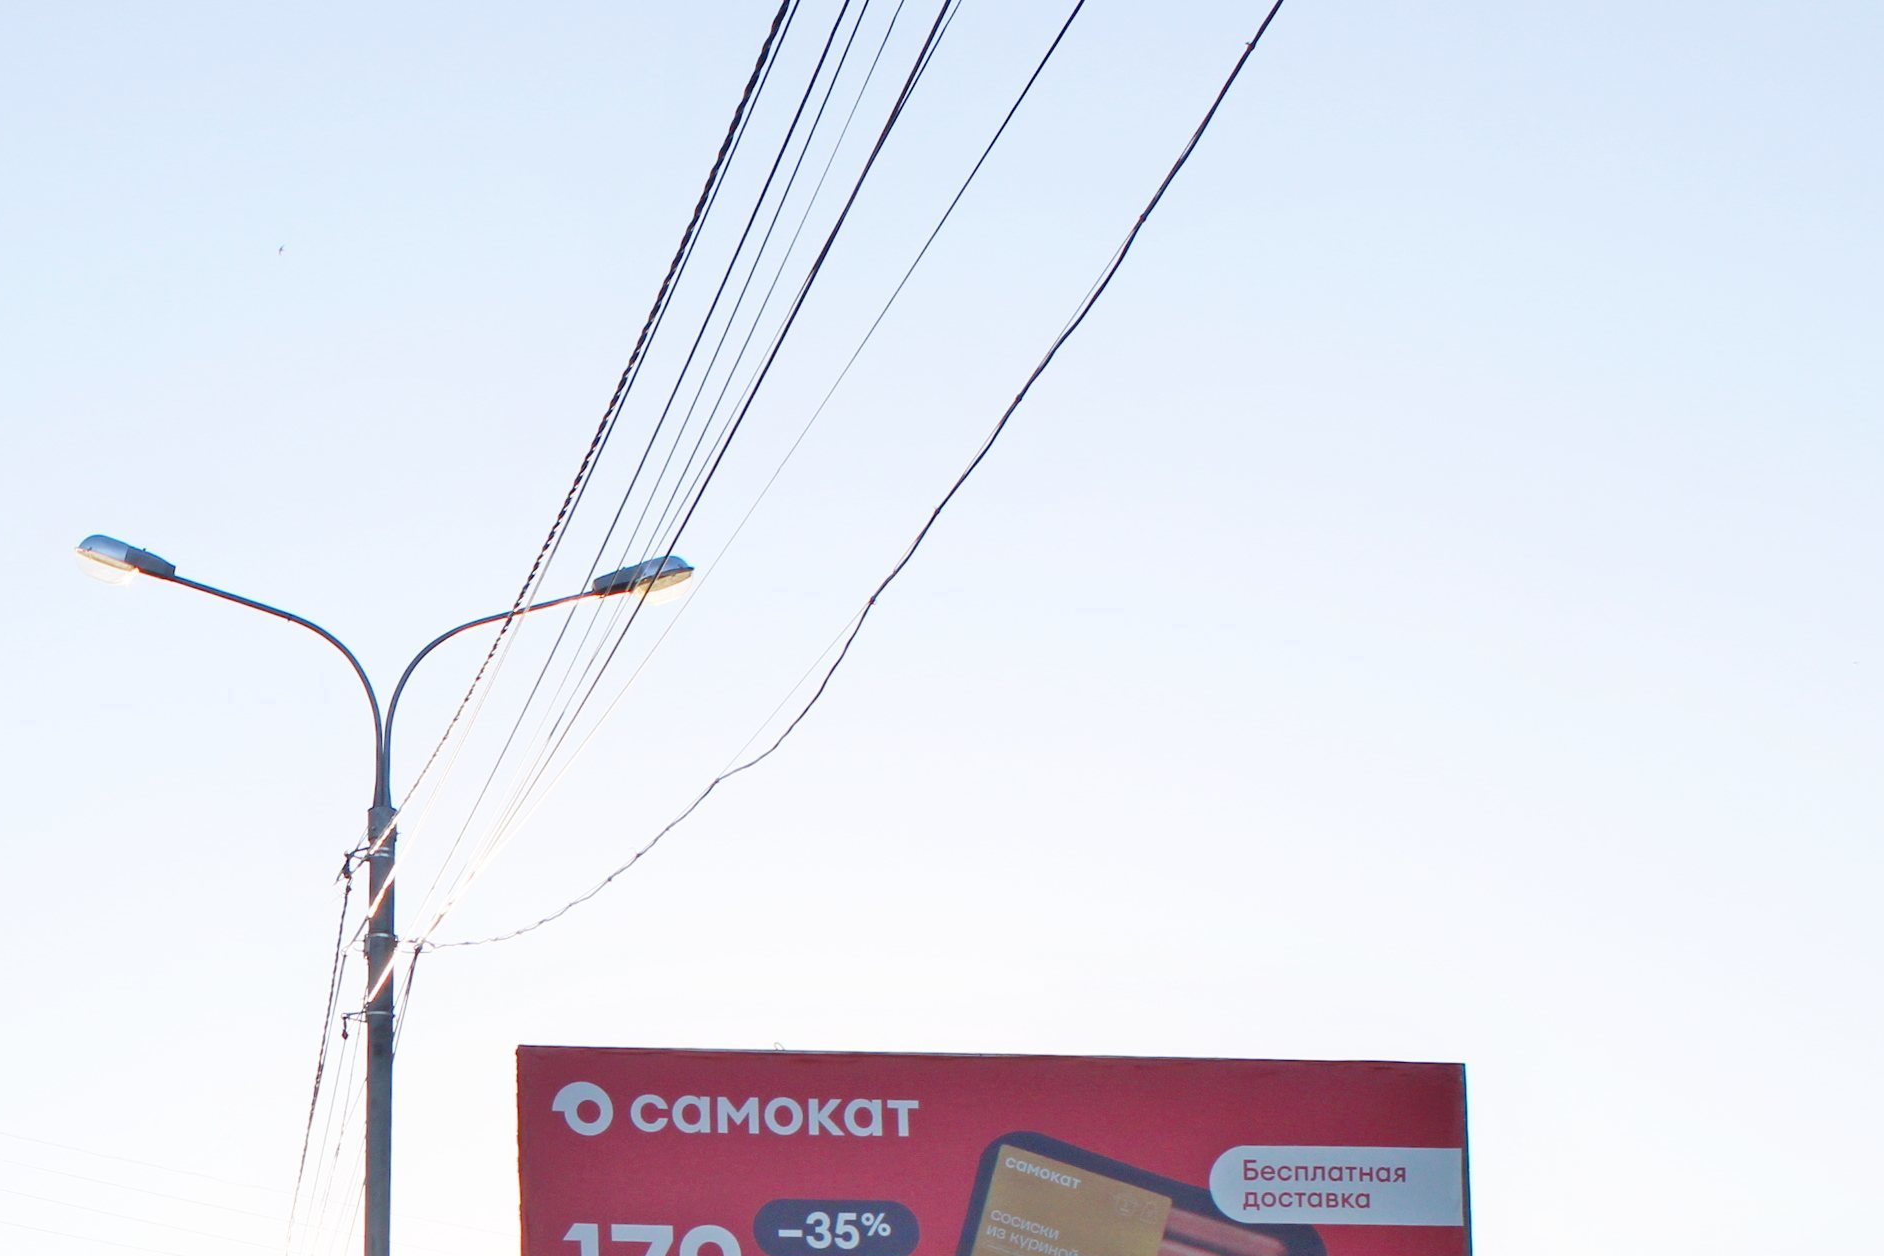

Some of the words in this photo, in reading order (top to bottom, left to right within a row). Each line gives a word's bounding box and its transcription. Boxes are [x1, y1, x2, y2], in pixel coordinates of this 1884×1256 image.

[630, 1093, 920, 1137] самокат
[1005, 1156, 1082, 1190] самокат
[1242, 1159, 1407, 1184] Бесплатная
[1242, 1191, 1372, 1211] доставка
[986, 1225, 1006, 1240] из
[990, 1209, 1060, 1240] сосиски
